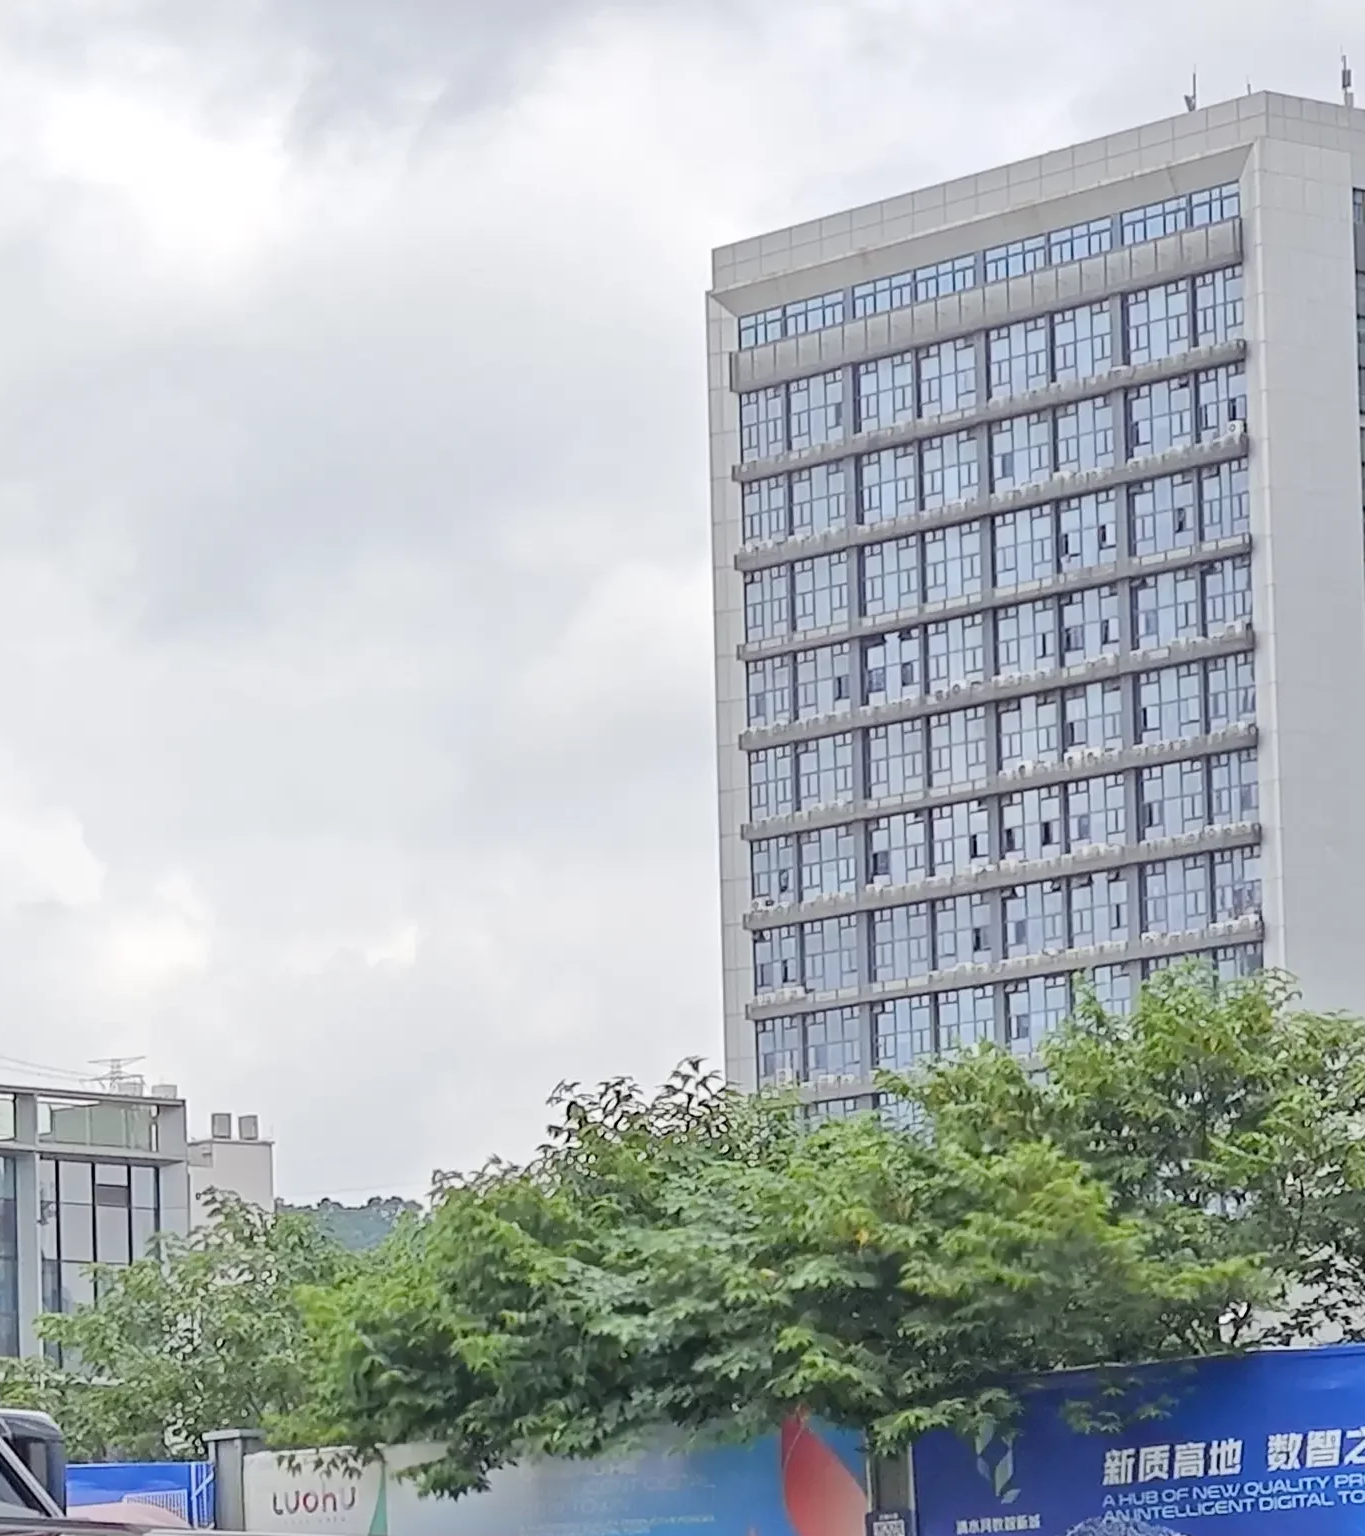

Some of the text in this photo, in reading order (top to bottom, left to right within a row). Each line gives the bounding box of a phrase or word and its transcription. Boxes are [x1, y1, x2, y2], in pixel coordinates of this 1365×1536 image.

[1102, 1437, 1243, 1486] 新质高地
[1102, 1473, 1365, 1507] A HUB OF NEW QUALITY PR
[1102, 1508, 1129, 1525] AN
[1134, 1498, 1256, 1523] INTELLIGENT
[1259, 1492, 1335, 1511] DIGITAL
